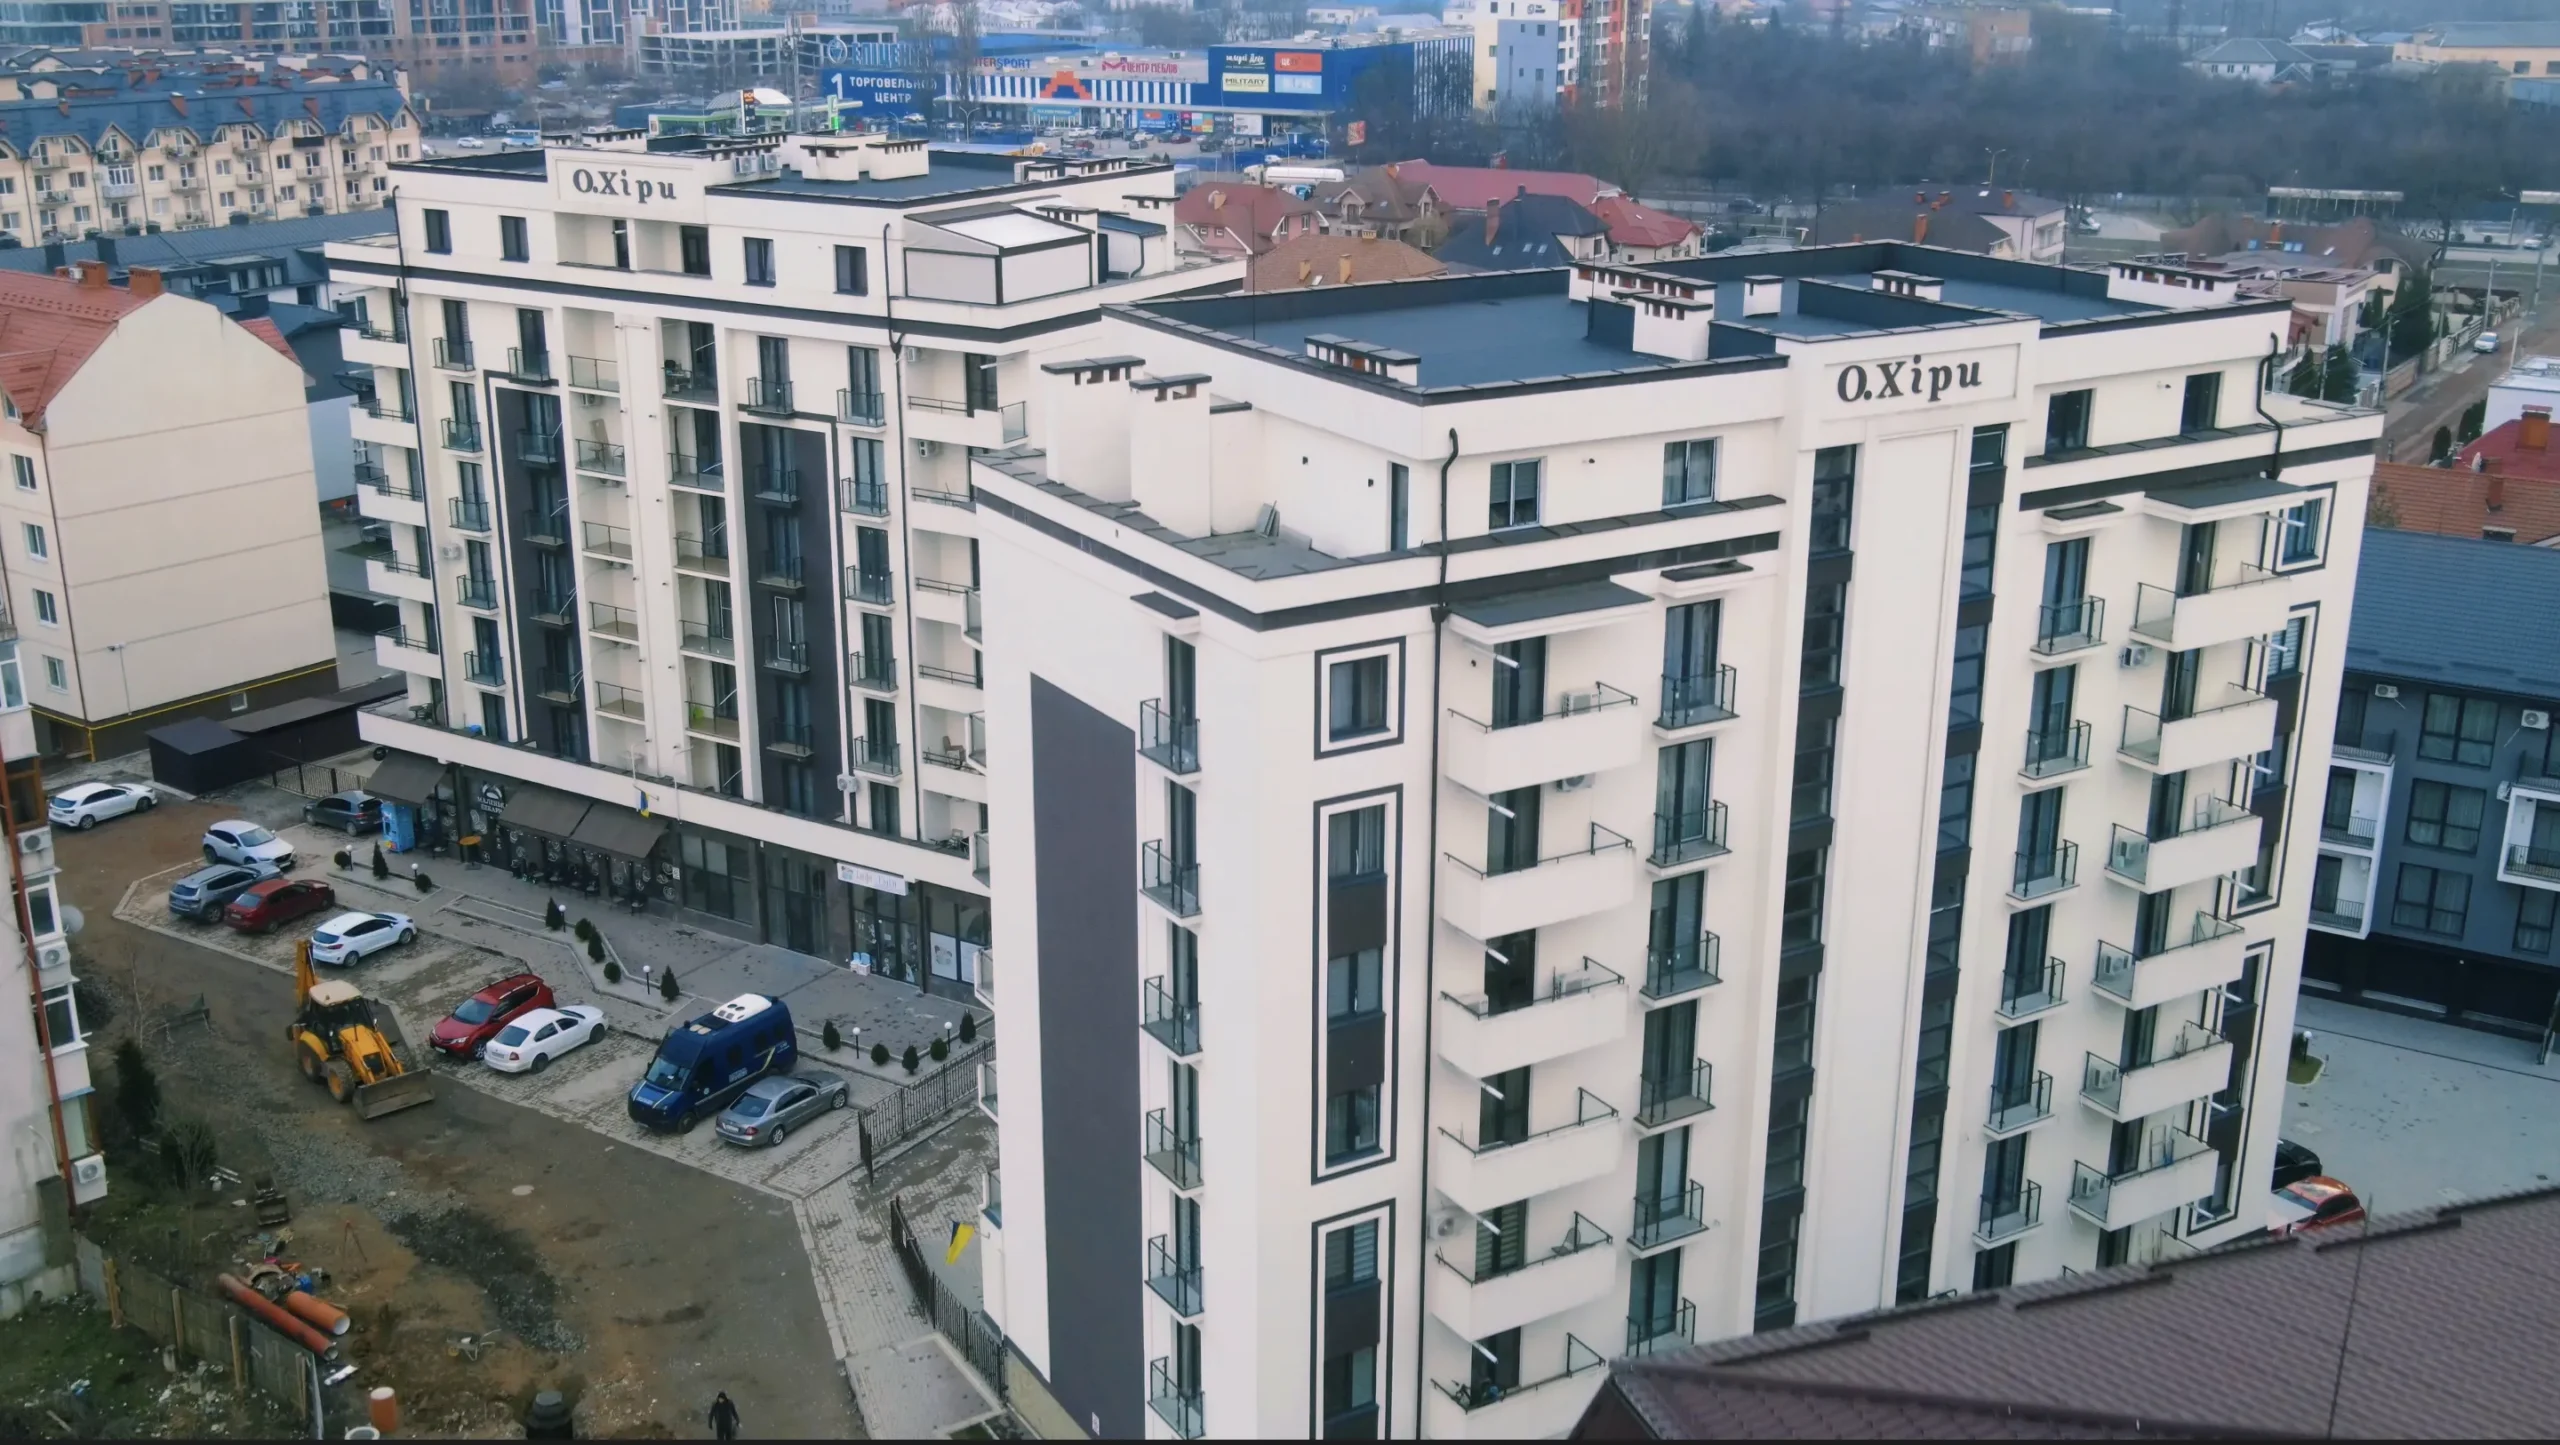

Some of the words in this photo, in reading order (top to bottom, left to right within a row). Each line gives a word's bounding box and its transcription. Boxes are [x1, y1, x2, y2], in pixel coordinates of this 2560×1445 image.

[1127, 62, 1149, 73] ЦЕНТР
[1151, 63, 1178, 74] МЕБЛІВ
[1225, 77, 1266, 86] MILITARY
[875, 92, 912, 104] ЦЕНТР
